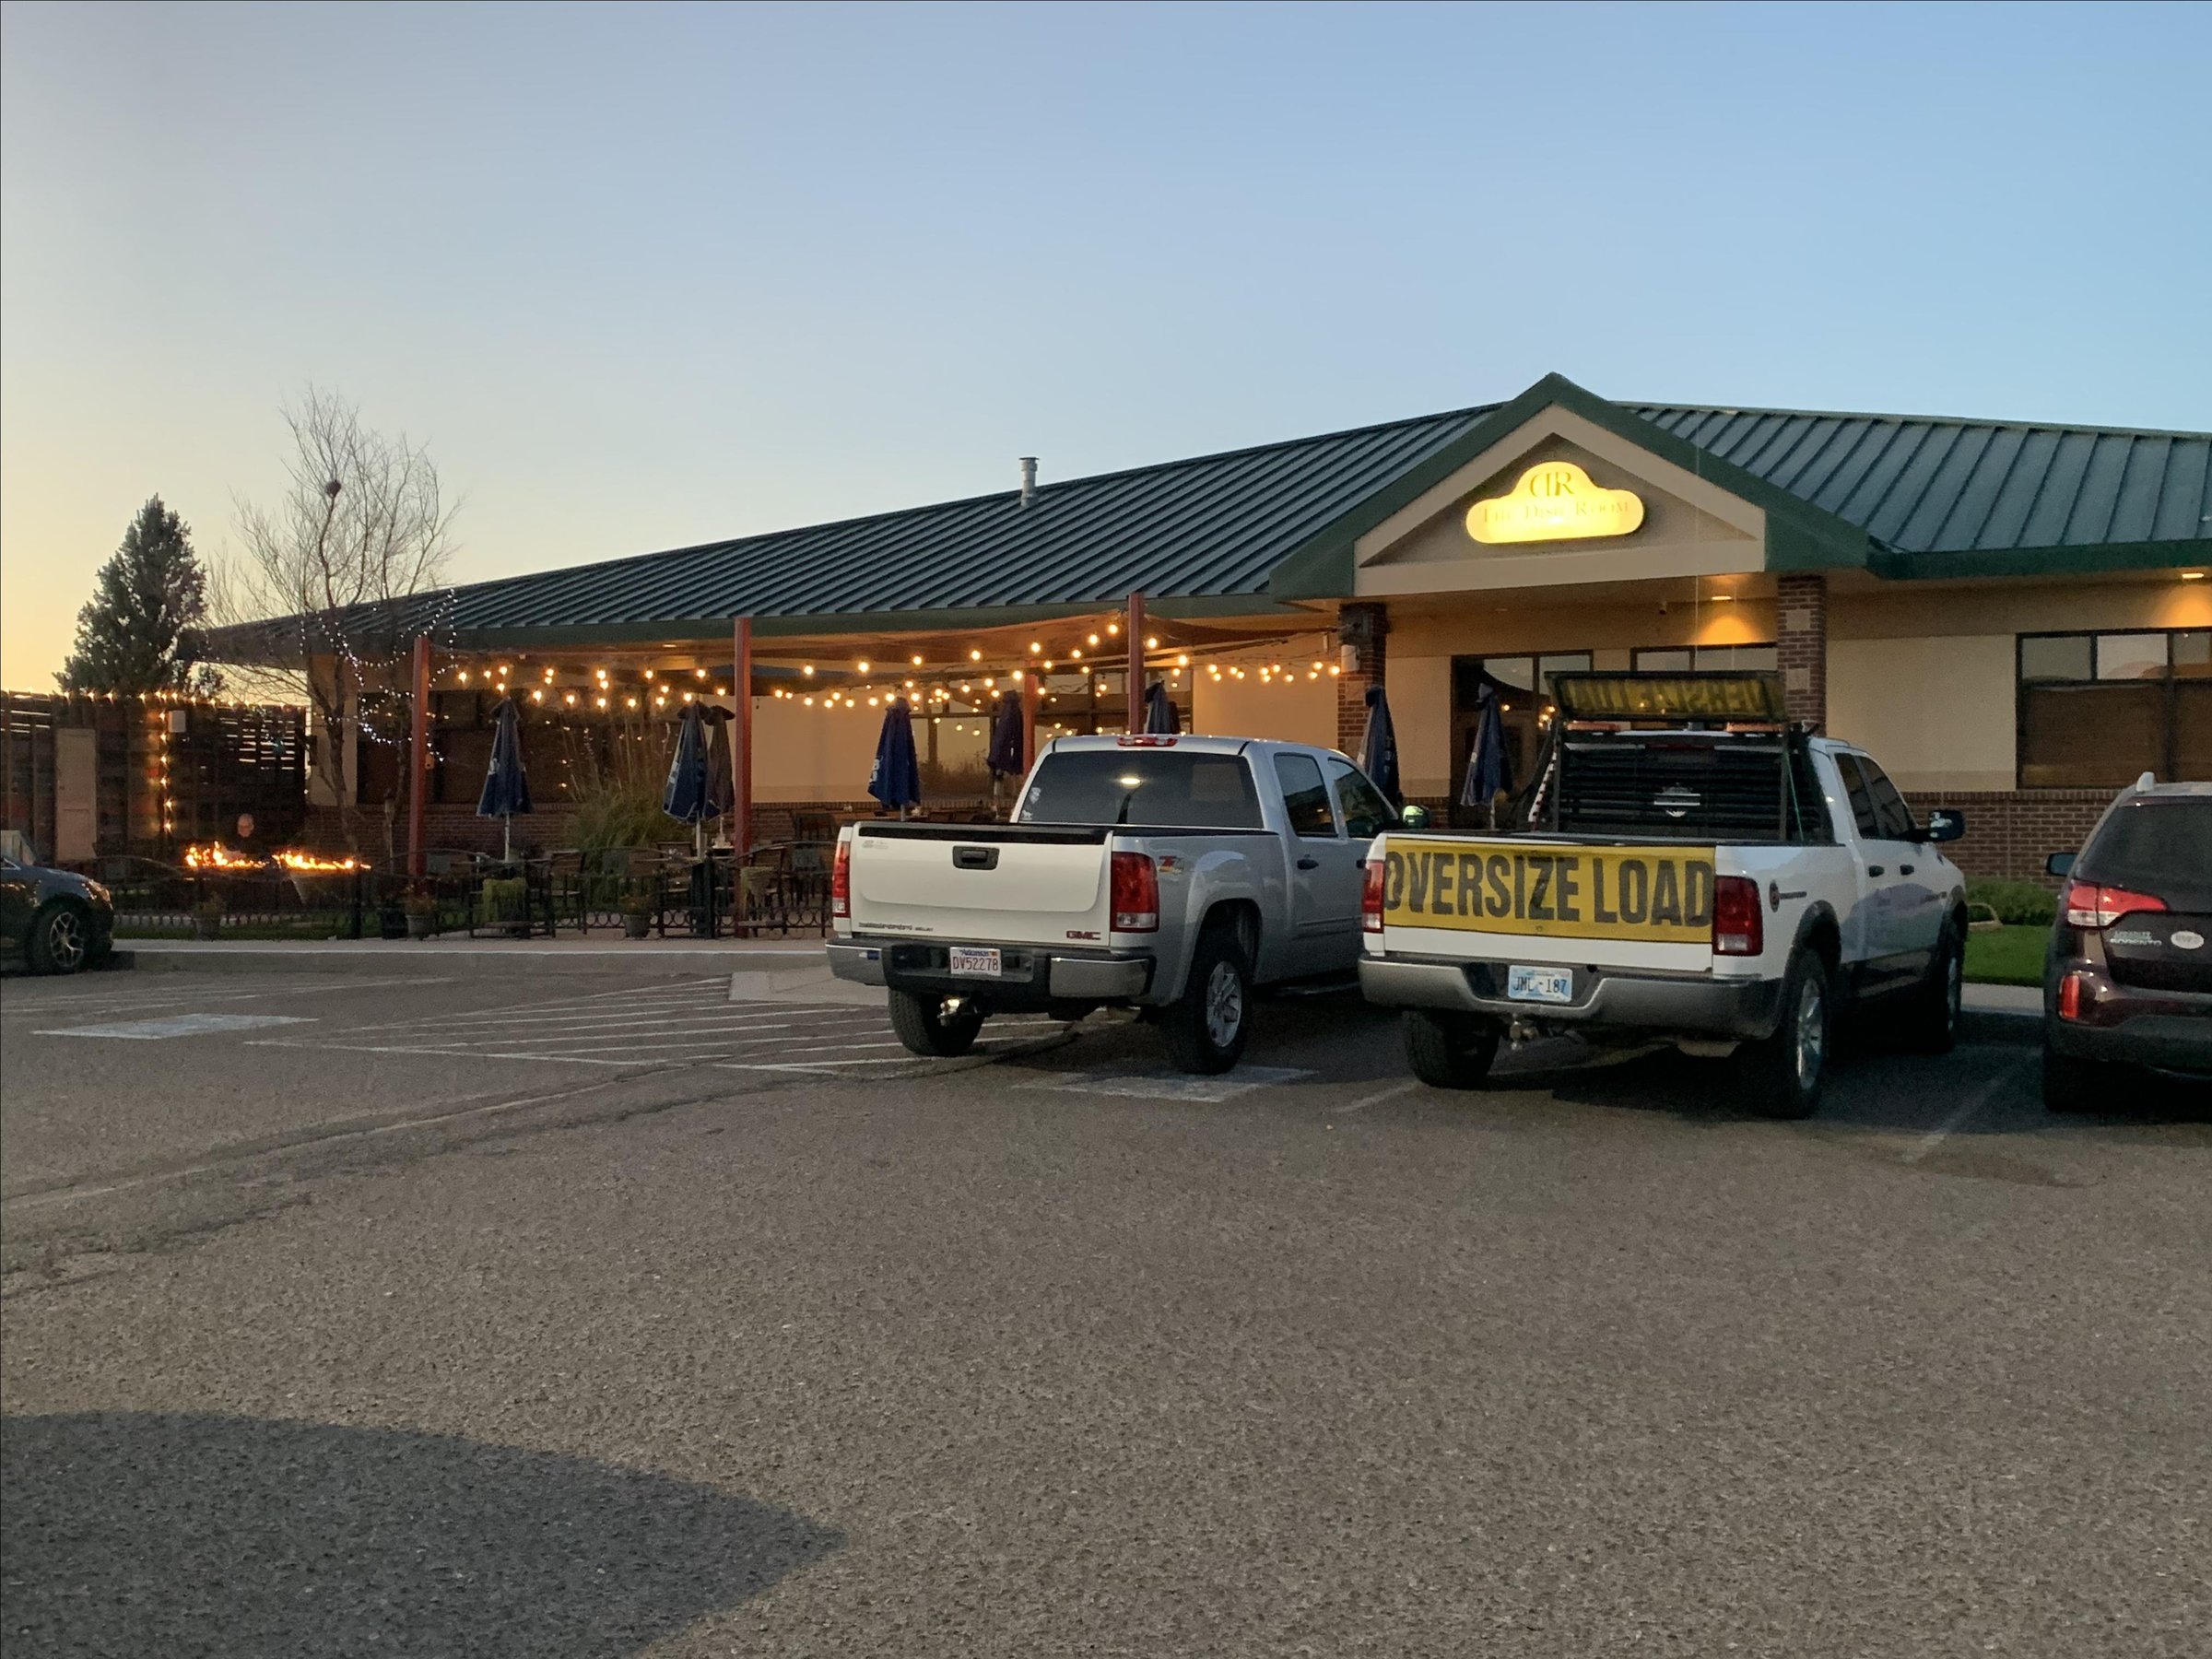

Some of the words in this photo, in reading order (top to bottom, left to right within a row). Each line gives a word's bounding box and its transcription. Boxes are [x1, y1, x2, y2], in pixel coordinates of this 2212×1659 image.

[1383, 851, 1580, 922] OVERSIZE
[1594, 857, 1712, 927] LOAD
[1066, 930, 1100, 940] GMC
[953, 956, 999, 971] DV52278
